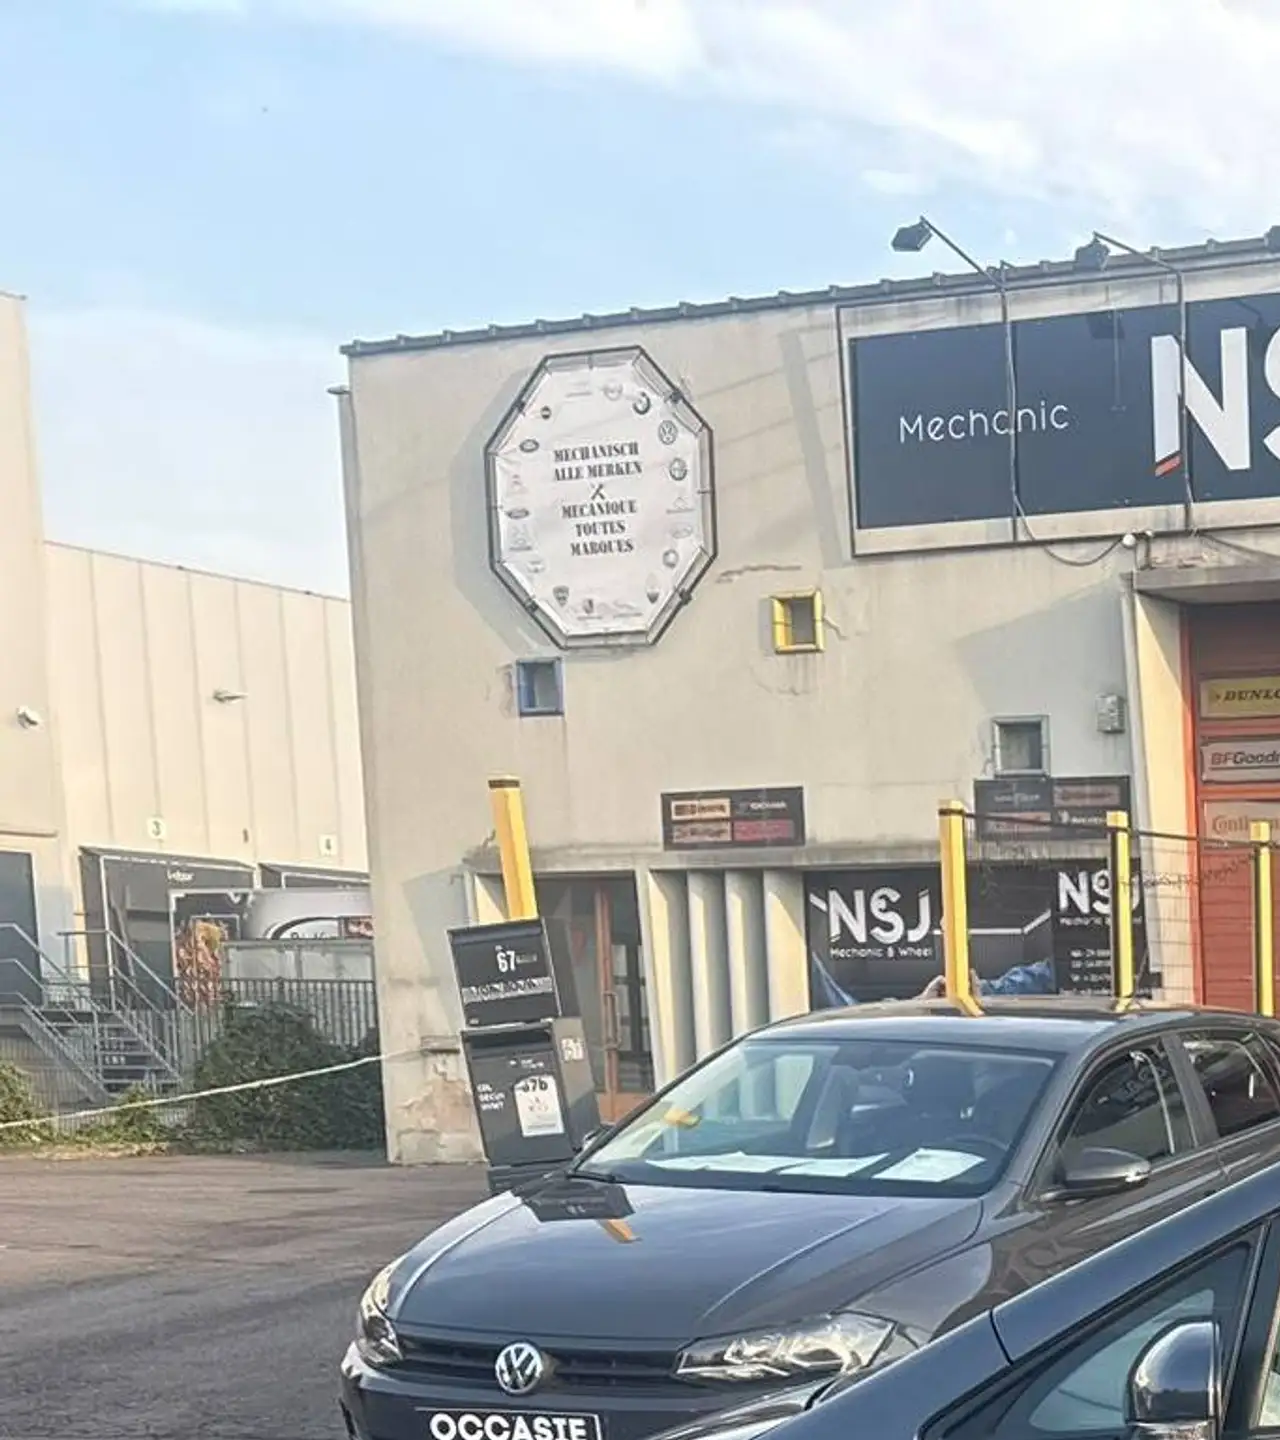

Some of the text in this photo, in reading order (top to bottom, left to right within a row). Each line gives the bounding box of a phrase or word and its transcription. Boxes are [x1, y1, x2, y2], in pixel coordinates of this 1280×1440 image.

[898, 400, 1070, 444] Mechanic
[554, 441, 640, 464] MECHANISCH
[553, 461, 643, 482] ALLE MERKEN
[561, 499, 637, 520] MECANIQUE
[575, 520, 626, 537] TOUTES
[570, 538, 635, 557] MARQUES
[828, 887, 931, 943] NSJ
[496, 951, 516, 972] 67
